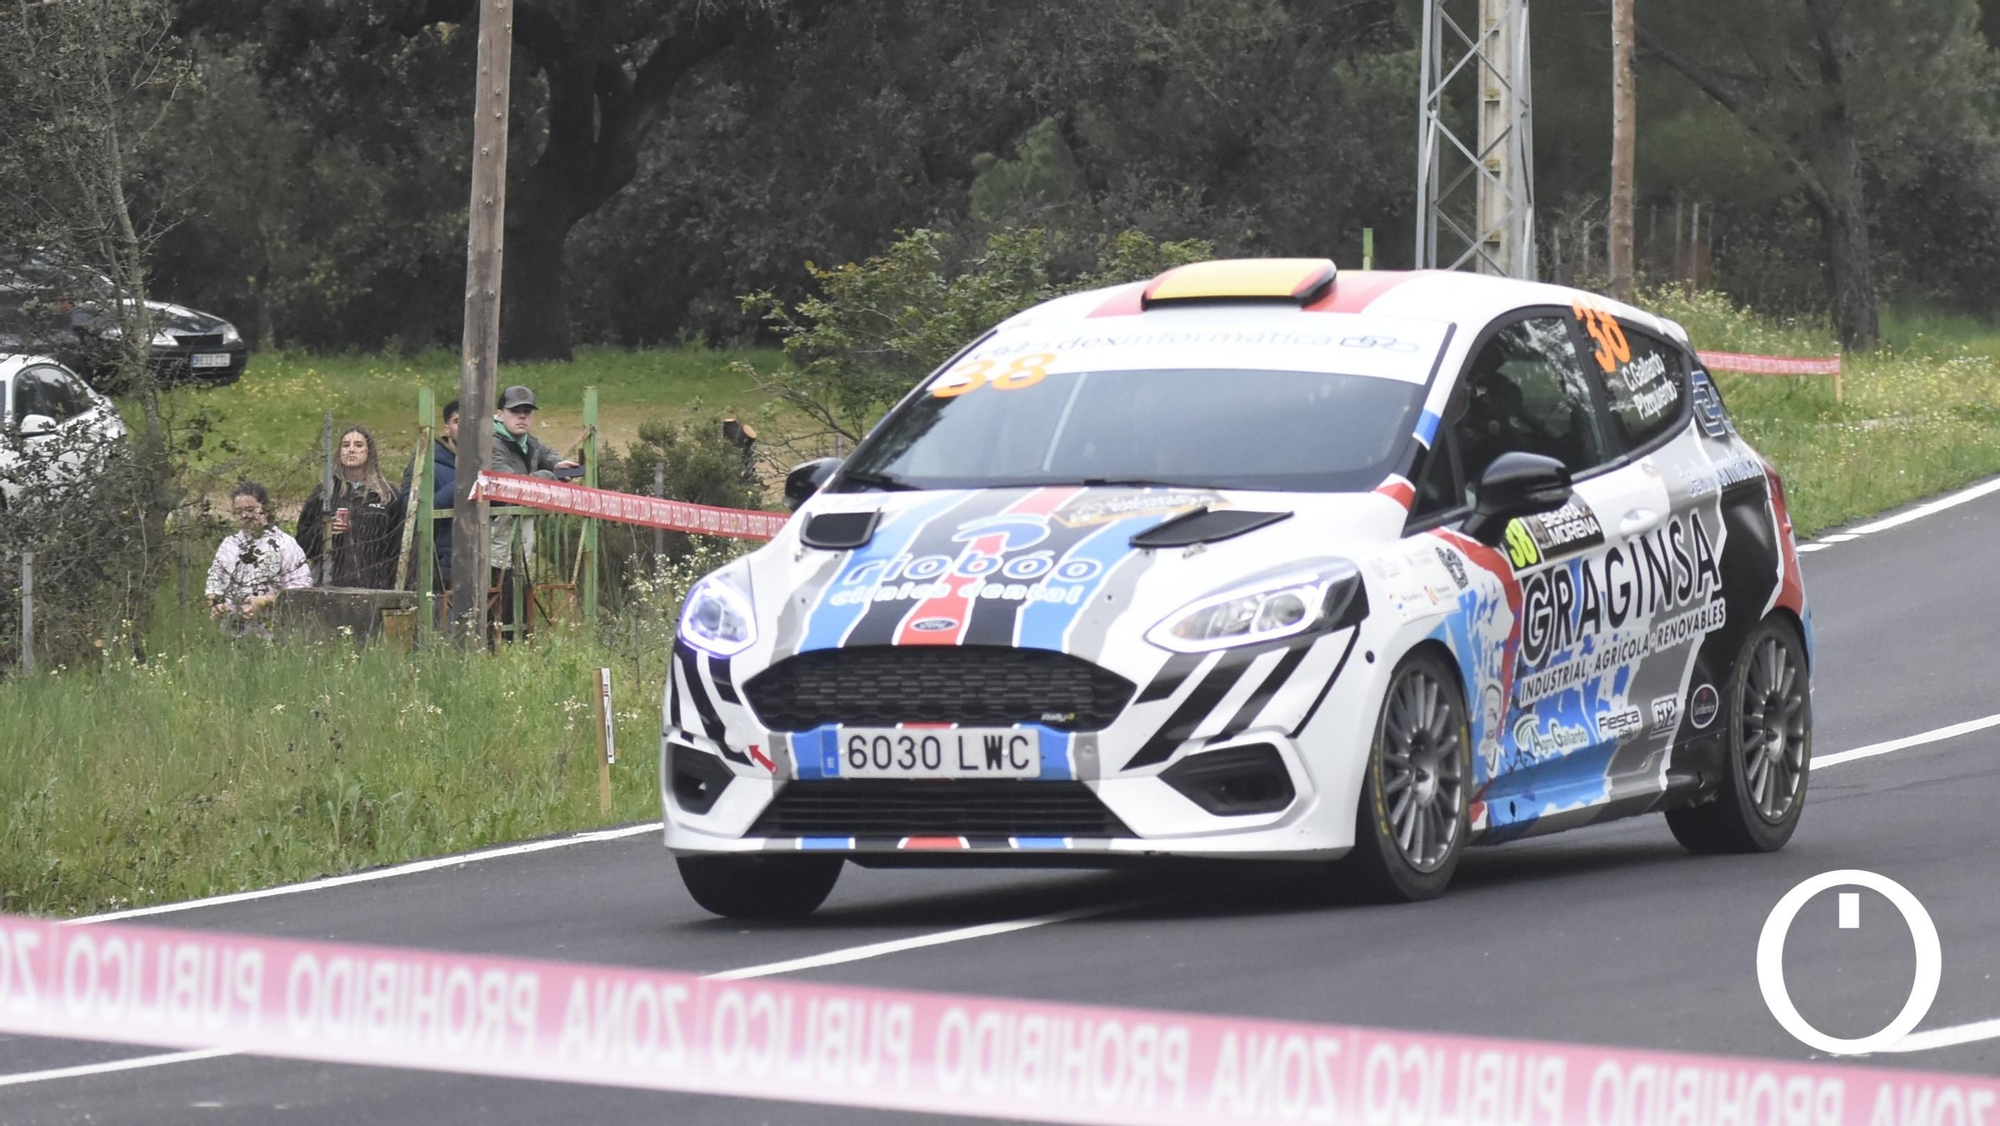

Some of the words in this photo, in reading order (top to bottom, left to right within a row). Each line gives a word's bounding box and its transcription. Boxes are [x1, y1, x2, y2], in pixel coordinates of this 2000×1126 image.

[931, 353, 1057, 397] 38
[1505, 517, 1538, 568] 38
[1547, 516, 1600, 546] MORENA
[957, 579, 1085, 604] dental
[1523, 511, 1721, 664] GRAGINSA
[1521, 659, 1586, 700] INDUSTRIAL
[1594, 636, 1649, 676] AGRÍCOLA
[1656, 601, 1725, 648] RENOVABLES
[1598, 711, 1640, 732] Fiesta
[847, 735, 942, 771] 6030
[958, 735, 1030, 771] LWC
